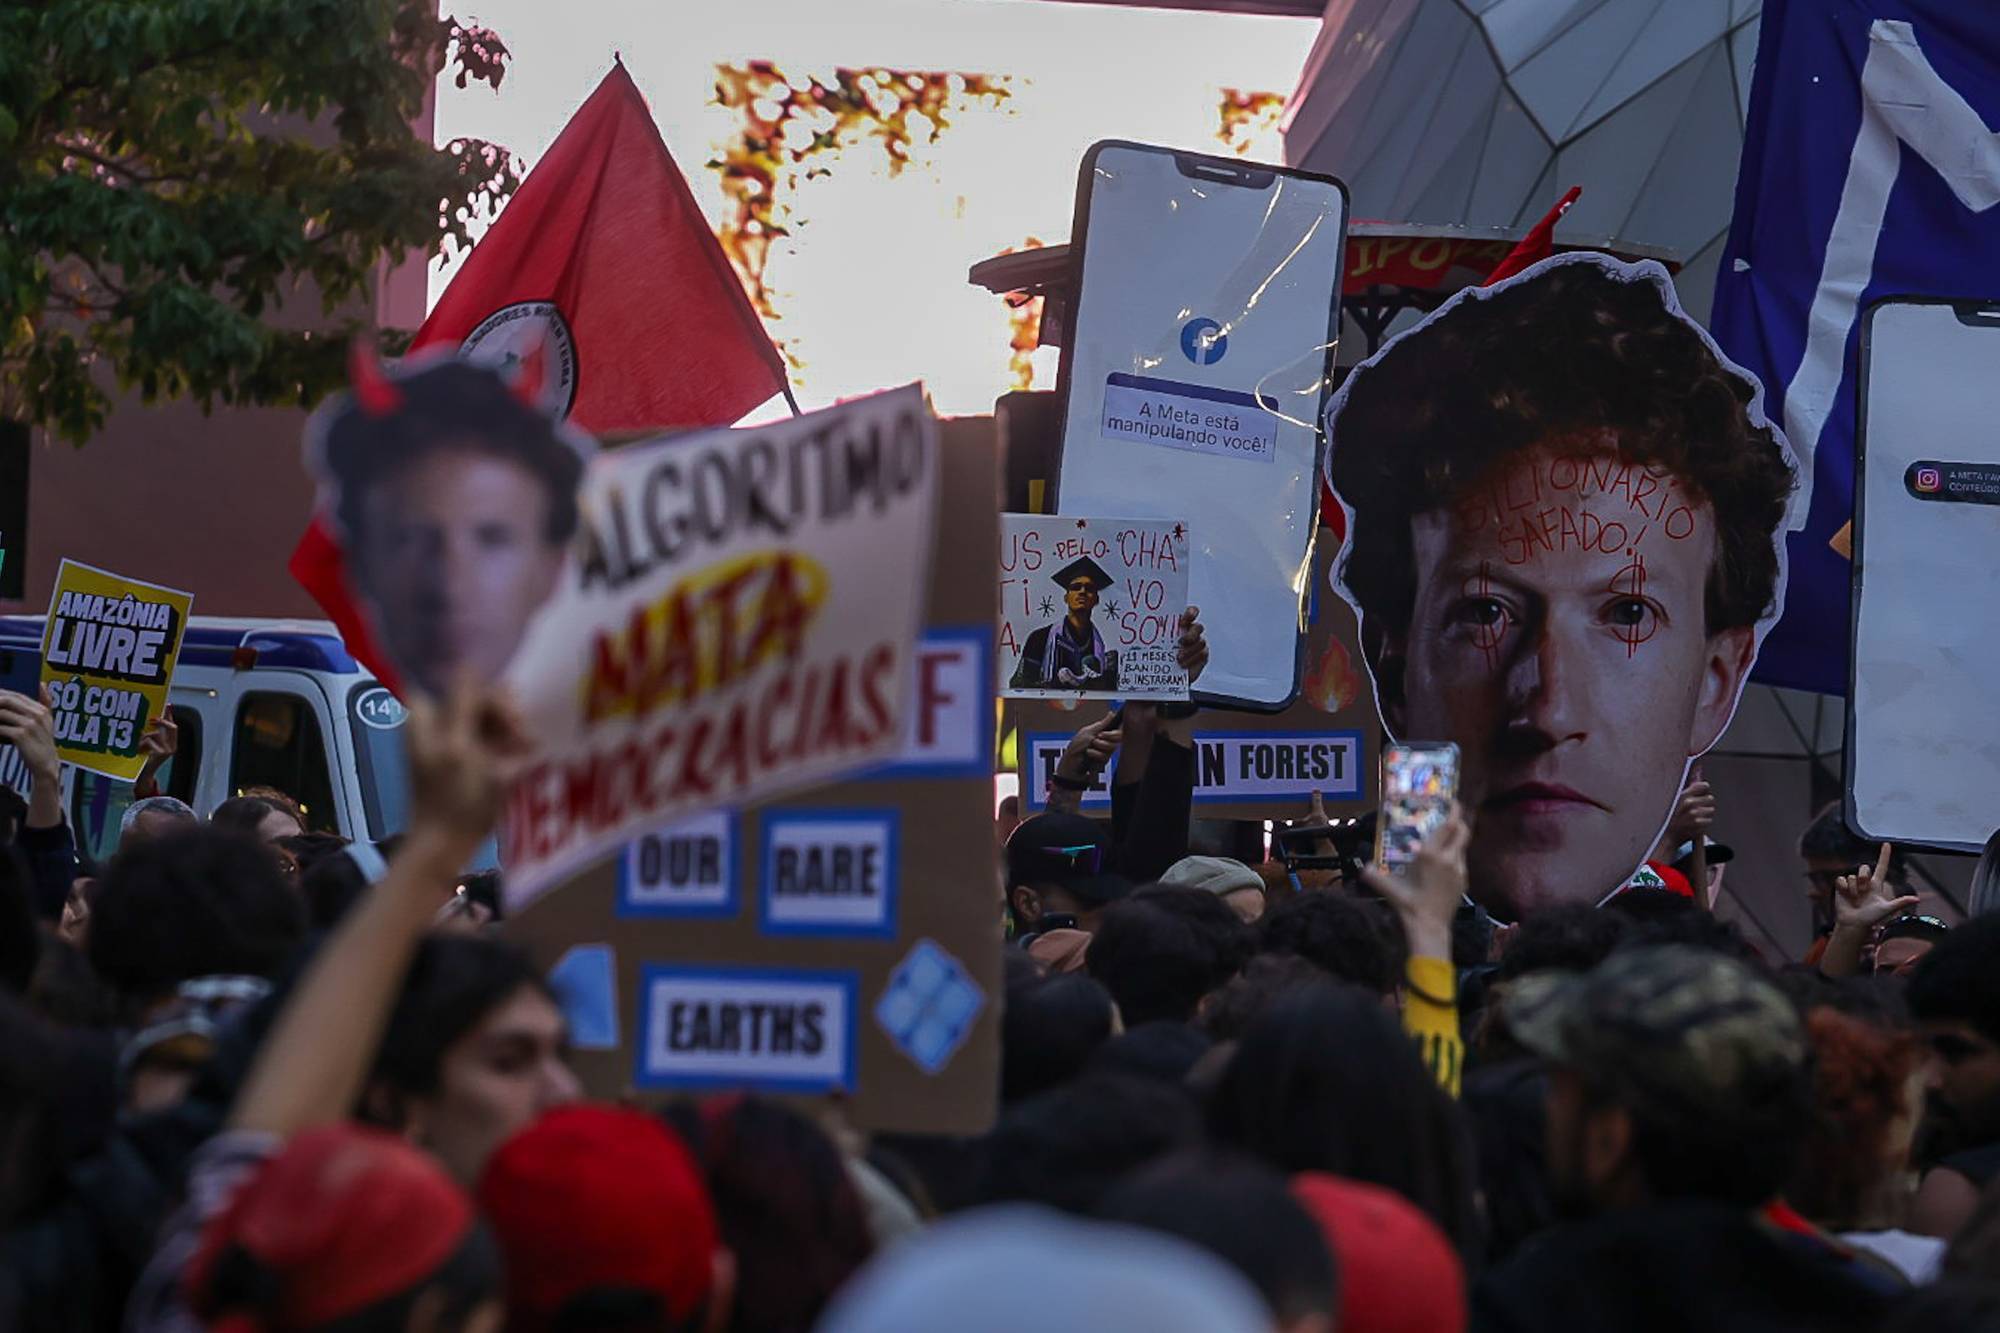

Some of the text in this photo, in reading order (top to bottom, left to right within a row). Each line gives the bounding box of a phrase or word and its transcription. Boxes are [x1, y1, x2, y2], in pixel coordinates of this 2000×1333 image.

[1107, 416, 1268, 453] manipulando você!
[1139, 401, 1240, 432] A Meta está
[1958, 471, 1984, 481] META
[580, 413, 926, 591] ALGORITMO
[1499, 507, 1648, 565] SAFADO!
[56, 591, 170, 629] AMAZÔNIA
[1127, 578, 1164, 611] VO
[47, 618, 164, 675] LIVRE
[583, 550, 816, 725] MATA
[1142, 651, 1175, 662] MESES
[1123, 663, 1171, 675] BANIDO
[47, 676, 142, 721] SÓ COM
[917, 652, 964, 746] F
[54, 711, 134, 750] ULA 13
[1239, 744, 1348, 780] FOREST
[638, 834, 878, 898] OUR RARE
[667, 1000, 827, 1056] EARTHS
